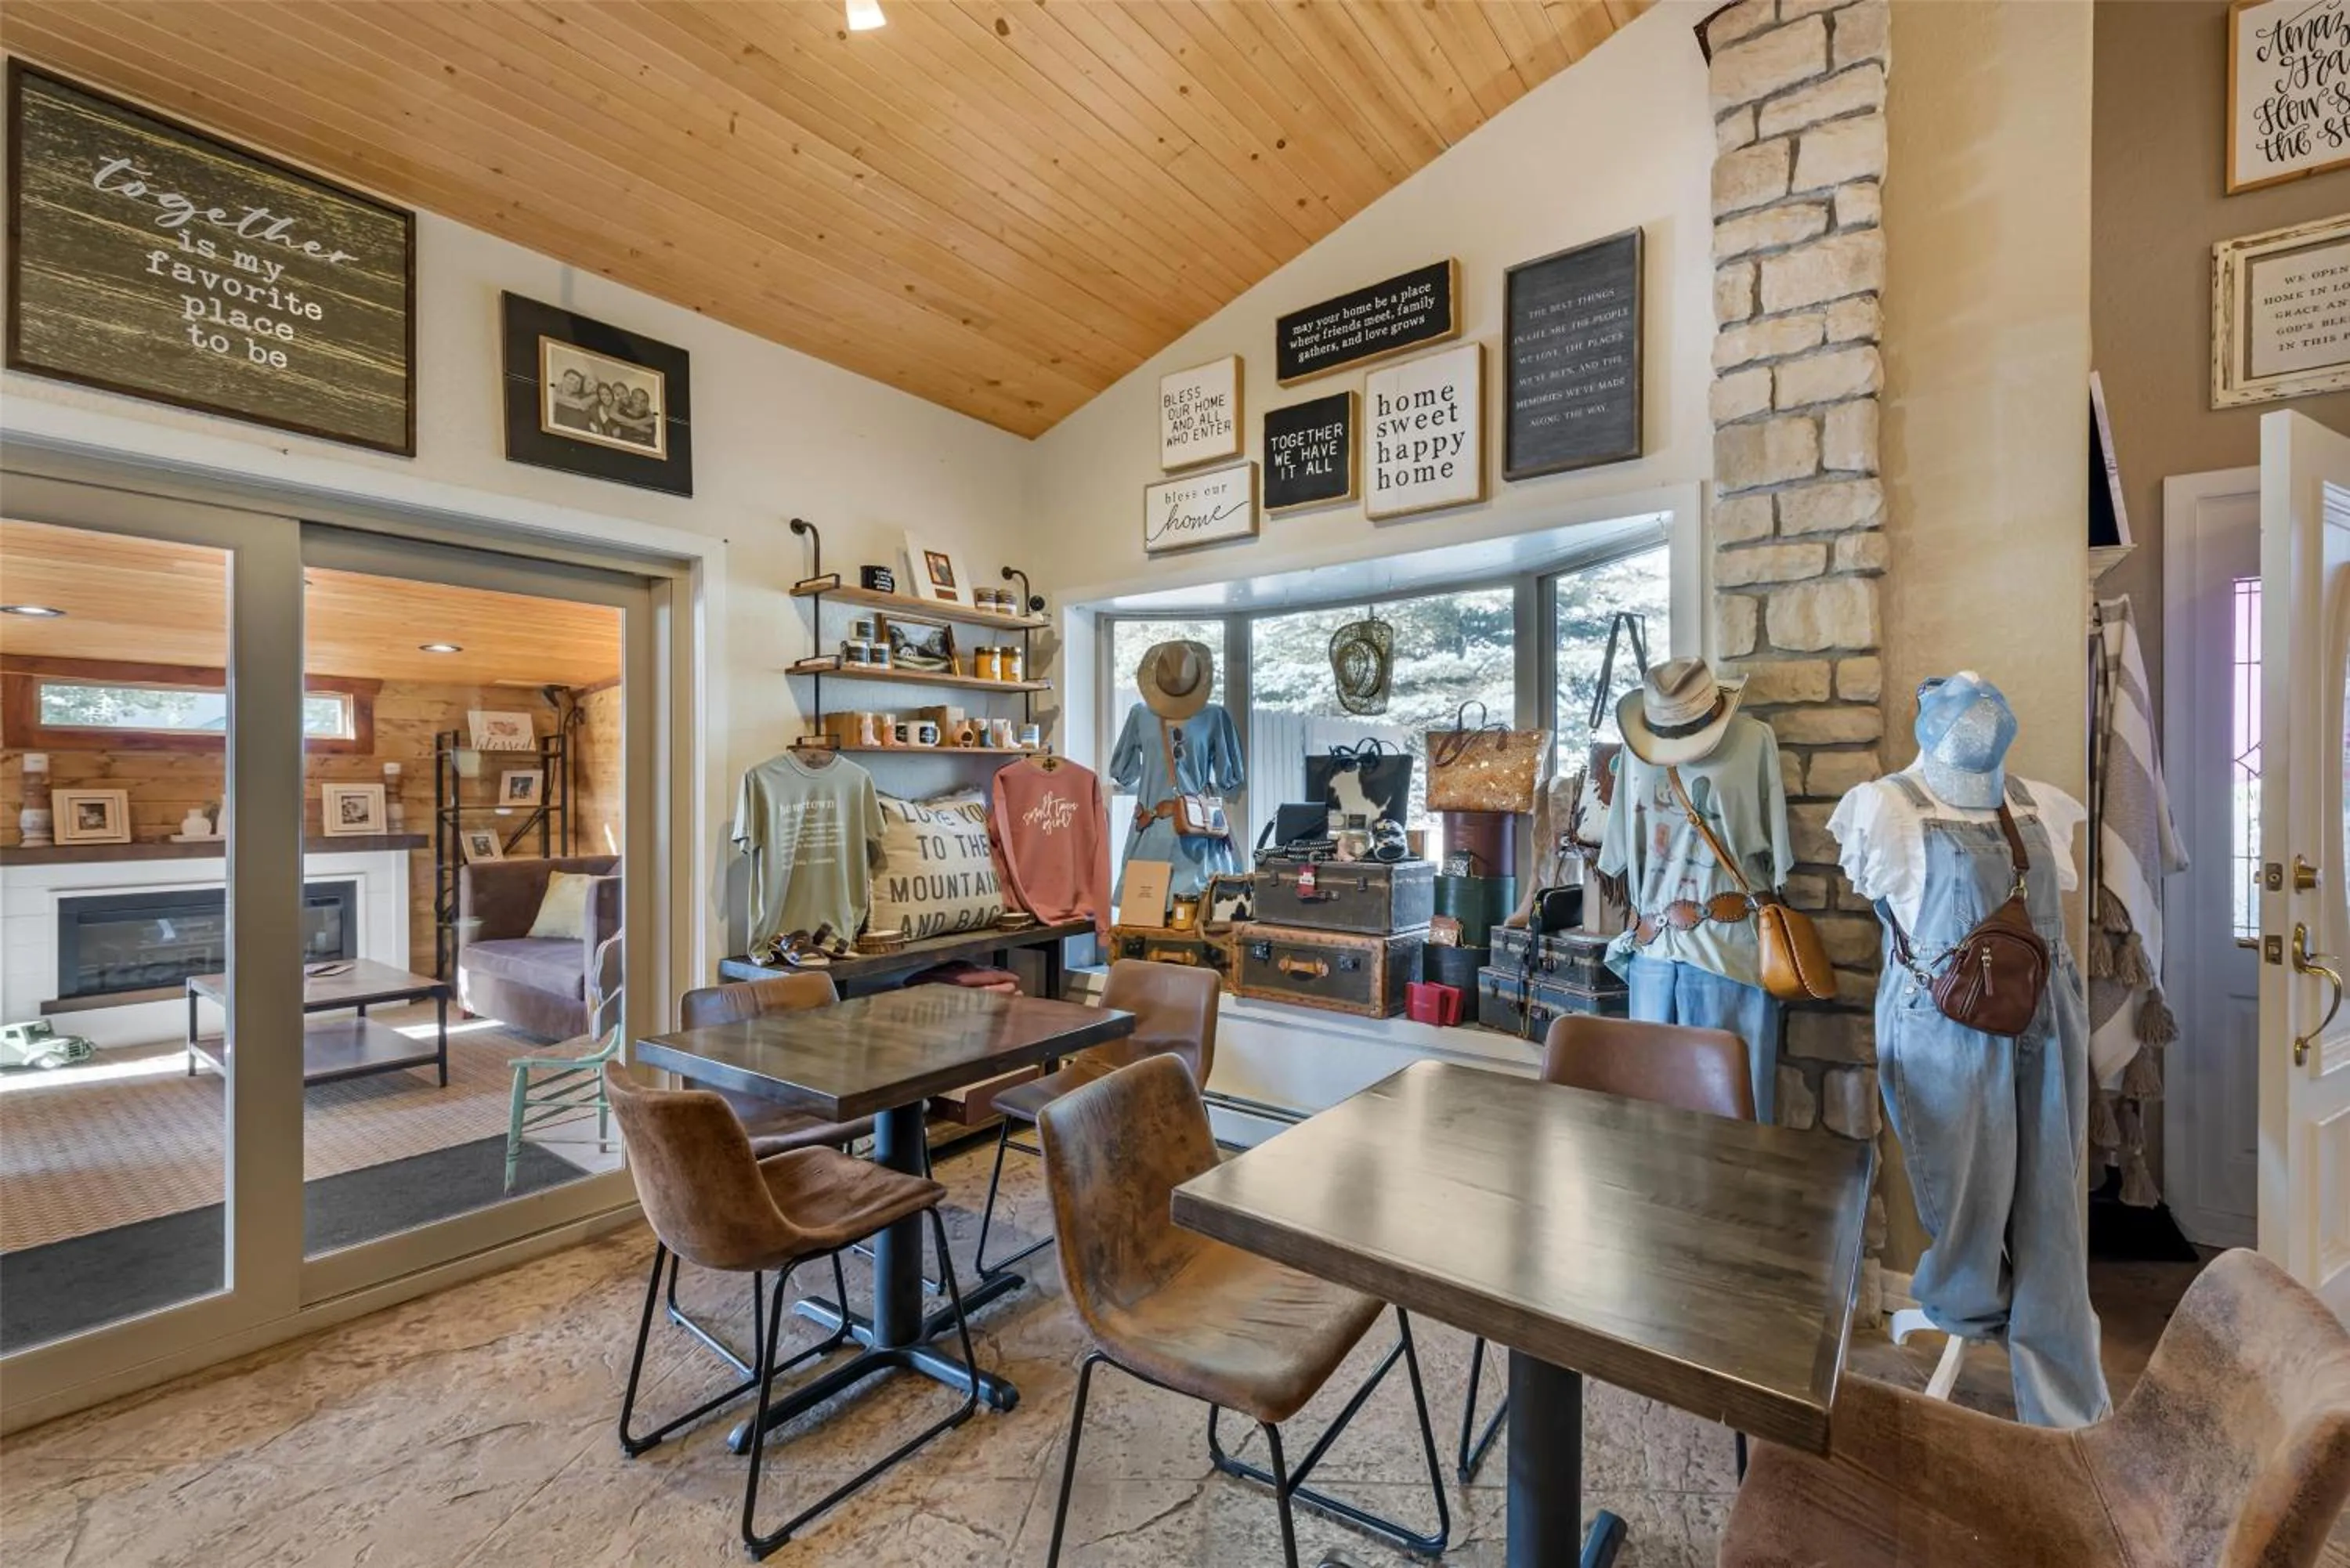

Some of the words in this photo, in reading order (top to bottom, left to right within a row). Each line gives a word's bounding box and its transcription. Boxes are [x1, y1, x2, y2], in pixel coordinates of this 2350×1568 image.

[2254, 87, 2330, 135] How
[2255, 123, 2312, 162] the
[93, 156, 360, 263] together
[178, 228, 217, 259] is
[233, 250, 285, 283] my
[145, 250, 324, 321] favorite
[2284, 274, 2306, 285] WE
[1292, 320, 1314, 336] may
[1316, 312, 1340, 329] your
[1342, 302, 1372, 320] home
[1375, 296, 1388, 309] be
[1390, 294, 1397, 304] a
[1401, 282, 1432, 302] place
[1528, 307, 1547, 320] THE
[1578, 287, 1615, 307] THINGS
[2264, 291, 2305, 306] HOME
[2310, 284, 2327, 297] IN
[180, 294, 295, 341] place
[1289, 334, 1320, 350] where
[1323, 318, 1361, 339] friends
[1364, 309, 1395, 327] meet,
[1397, 294, 1436, 315] family
[2275, 305, 2320, 320] GRACE
[1297, 342, 1340, 363] gathers,
[1342, 331, 1362, 349] and
[1365, 323, 1388, 341] love
[1390, 313, 1426, 337] grows
[1587, 331, 1625, 348] PLACES
[2276, 322, 2314, 337] GOD'S
[2279, 340, 2295, 352] IN
[2301, 333, 2337, 348] THIS
[187, 323, 230, 353] to
[245, 337, 287, 369] be
[1578, 360, 1599, 374] AND
[1163, 386, 1202, 408] BLESS
[1168, 403, 1190, 421] OUR
[1195, 394, 1226, 414] HOME
[1377, 383, 1455, 417] home
[1516, 391, 1563, 410] MEMORIES
[1598, 376, 1626, 390] MADE
[1166, 432, 1188, 448] WHO
[1193, 419, 1232, 442] ENTER
[1171, 417, 1195, 433] AND
[1199, 410, 1220, 425] ALL
[1376, 402, 1459, 439] sweet
[1271, 421, 1344, 452] TOGETHER
[1377, 431, 1466, 464] happy
[1274, 450, 1292, 468] WE
[1301, 441, 1338, 463] HAVE
[1280, 464, 1297, 480] IT
[1306, 457, 1332, 476] ALL
[1377, 461, 1455, 491] home
[1165, 490, 1198, 505] bless
[1204, 483, 1227, 497] our
[1147, 500, 1249, 544] home
[916, 835, 947, 861] TO
[954, 834, 989, 858] THE
[900, 911, 945, 939] AND
